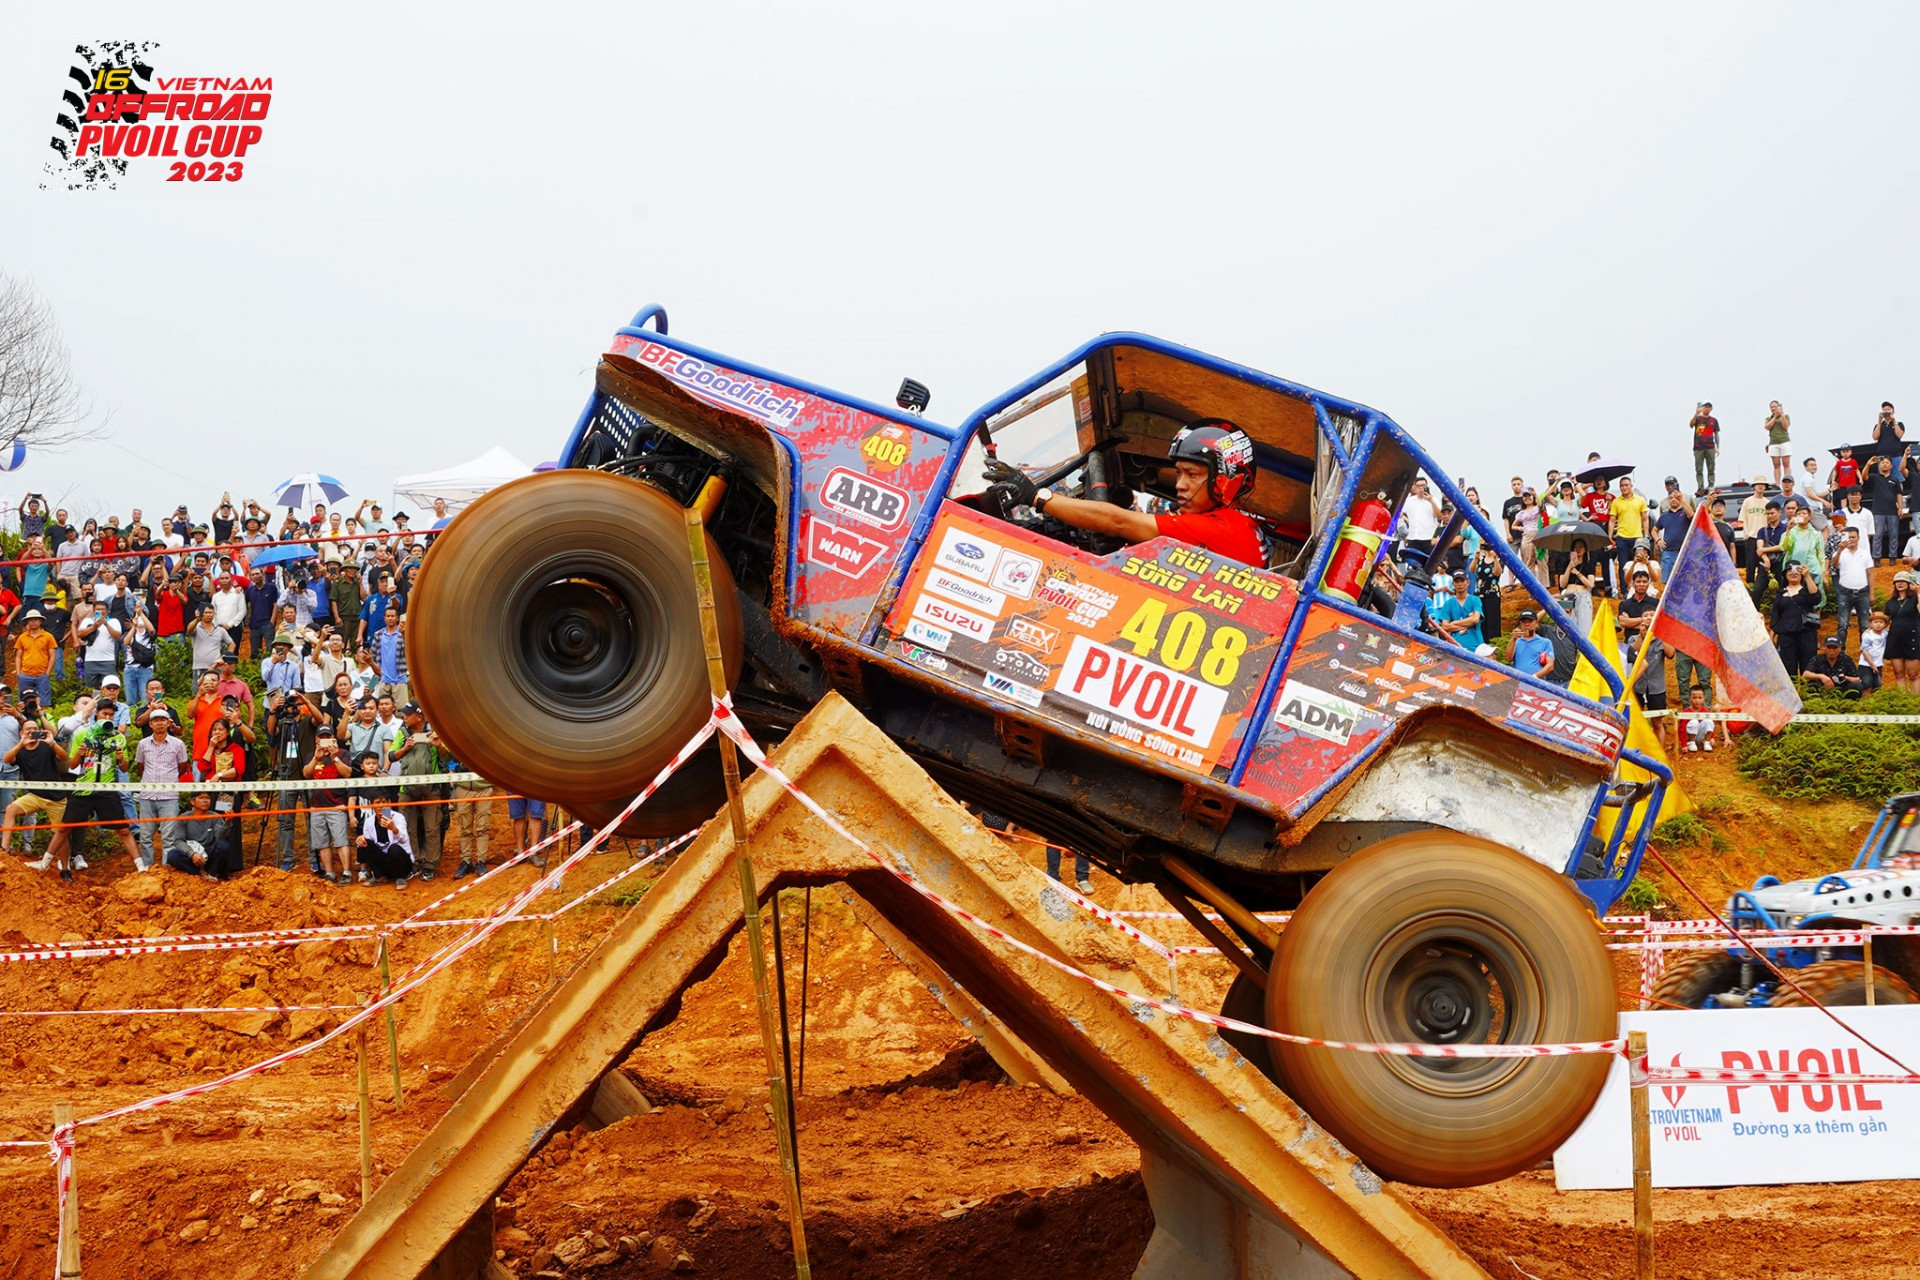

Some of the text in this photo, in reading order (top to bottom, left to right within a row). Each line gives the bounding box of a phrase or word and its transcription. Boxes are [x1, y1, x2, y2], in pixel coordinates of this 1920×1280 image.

[639, 344, 799, 420] BFGoodrich
[864, 435, 907, 466] 408
[829, 476, 900, 521] ARB
[818, 537, 862, 565] WARN
[945, 554, 984, 574] SUBARU
[1053, 570, 1118, 601] 16 VIETNAM
[1121, 557, 1244, 614] SÔNG LAM
[1167, 547, 1283, 601] NÚI HỒNG
[937, 578, 993, 604] BFGoodrich
[1037, 588, 1108, 620] PVOIL CUP
[1046, 578, 1116, 610] OFFROAD
[925, 604, 984, 633] ISUZU
[1066, 613, 1096, 628] 2023
[901, 641, 948, 671] VTVcab
[1009, 630, 1051, 653] MEDIA
[1120, 597, 1248, 687] 408
[1073, 646, 1198, 737] PVOIL
[1280, 699, 1354, 737] ADM
[1512, 701, 1620, 753] TURBO
[1177, 746, 1204, 767] LAM
[1722, 1048, 1882, 1114] PVOIL
[1650, 1108, 1722, 1124] TROVIETNAM
[1733, 1115, 1888, 1138] Đường xa thêm gần
[1664, 1126, 1702, 1142] PVOIL
